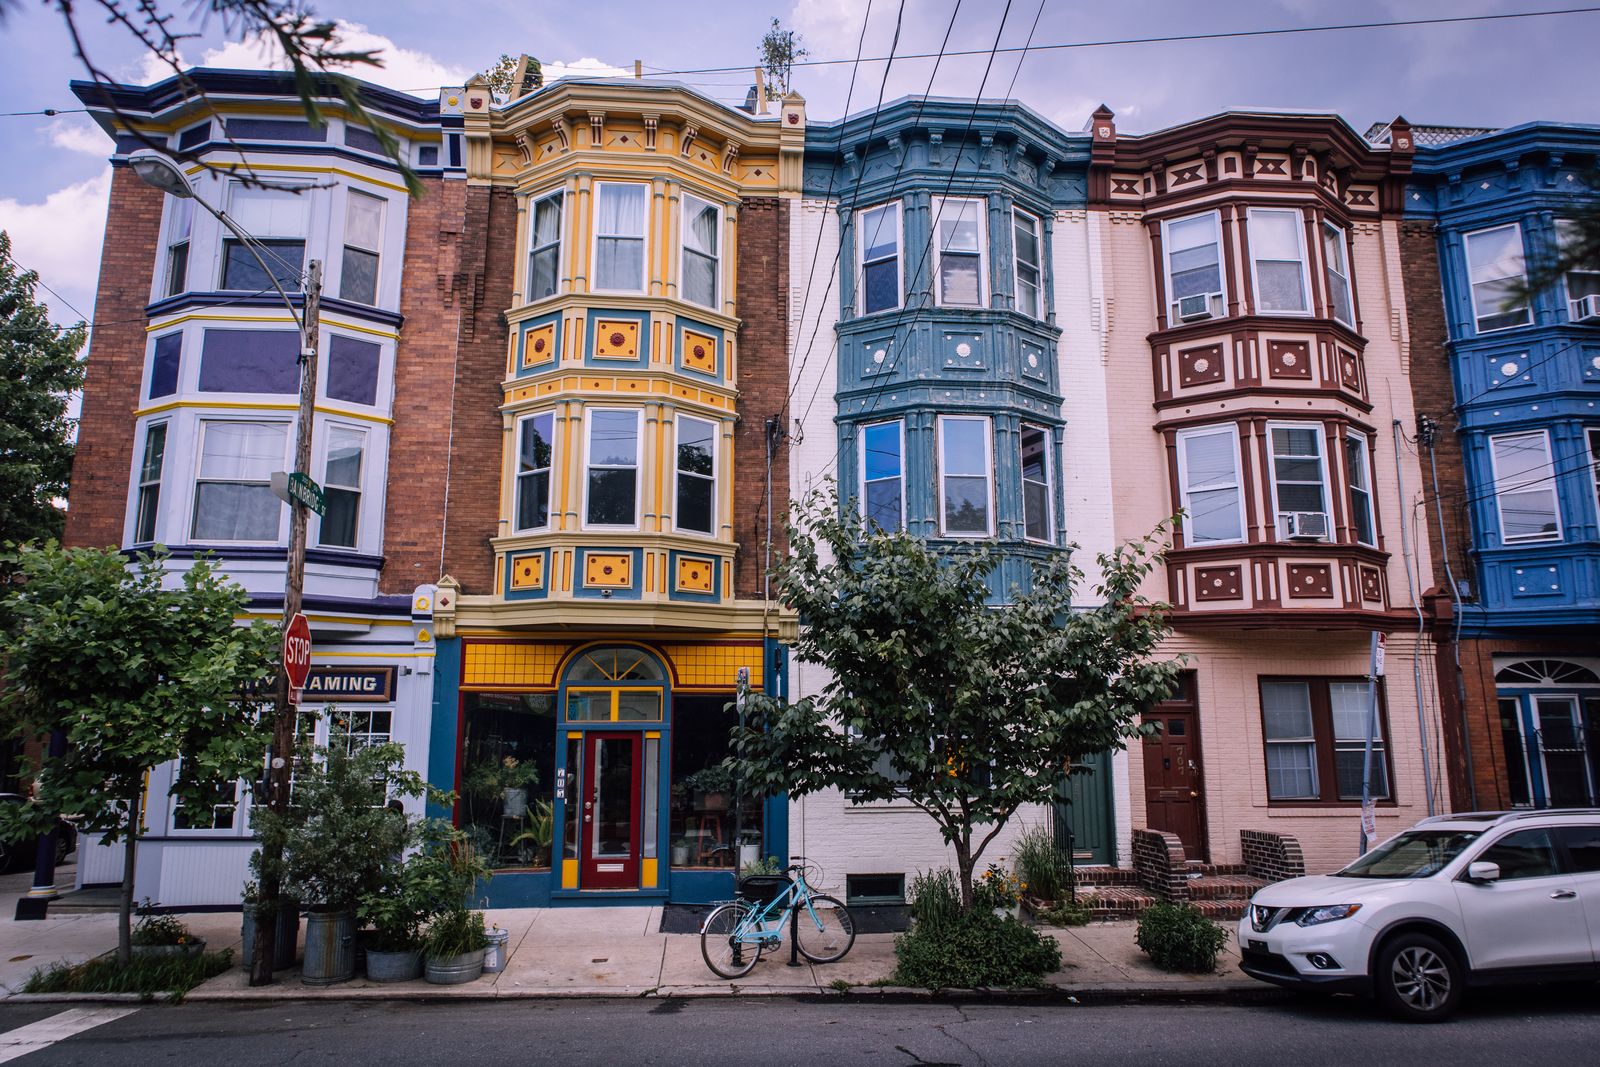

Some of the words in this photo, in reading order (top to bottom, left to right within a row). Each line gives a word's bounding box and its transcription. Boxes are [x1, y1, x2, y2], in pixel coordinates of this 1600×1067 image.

[287, 636, 310, 666] STOP
[303, 676, 377, 691] AMING
[1176, 746, 1185, 775] 707
